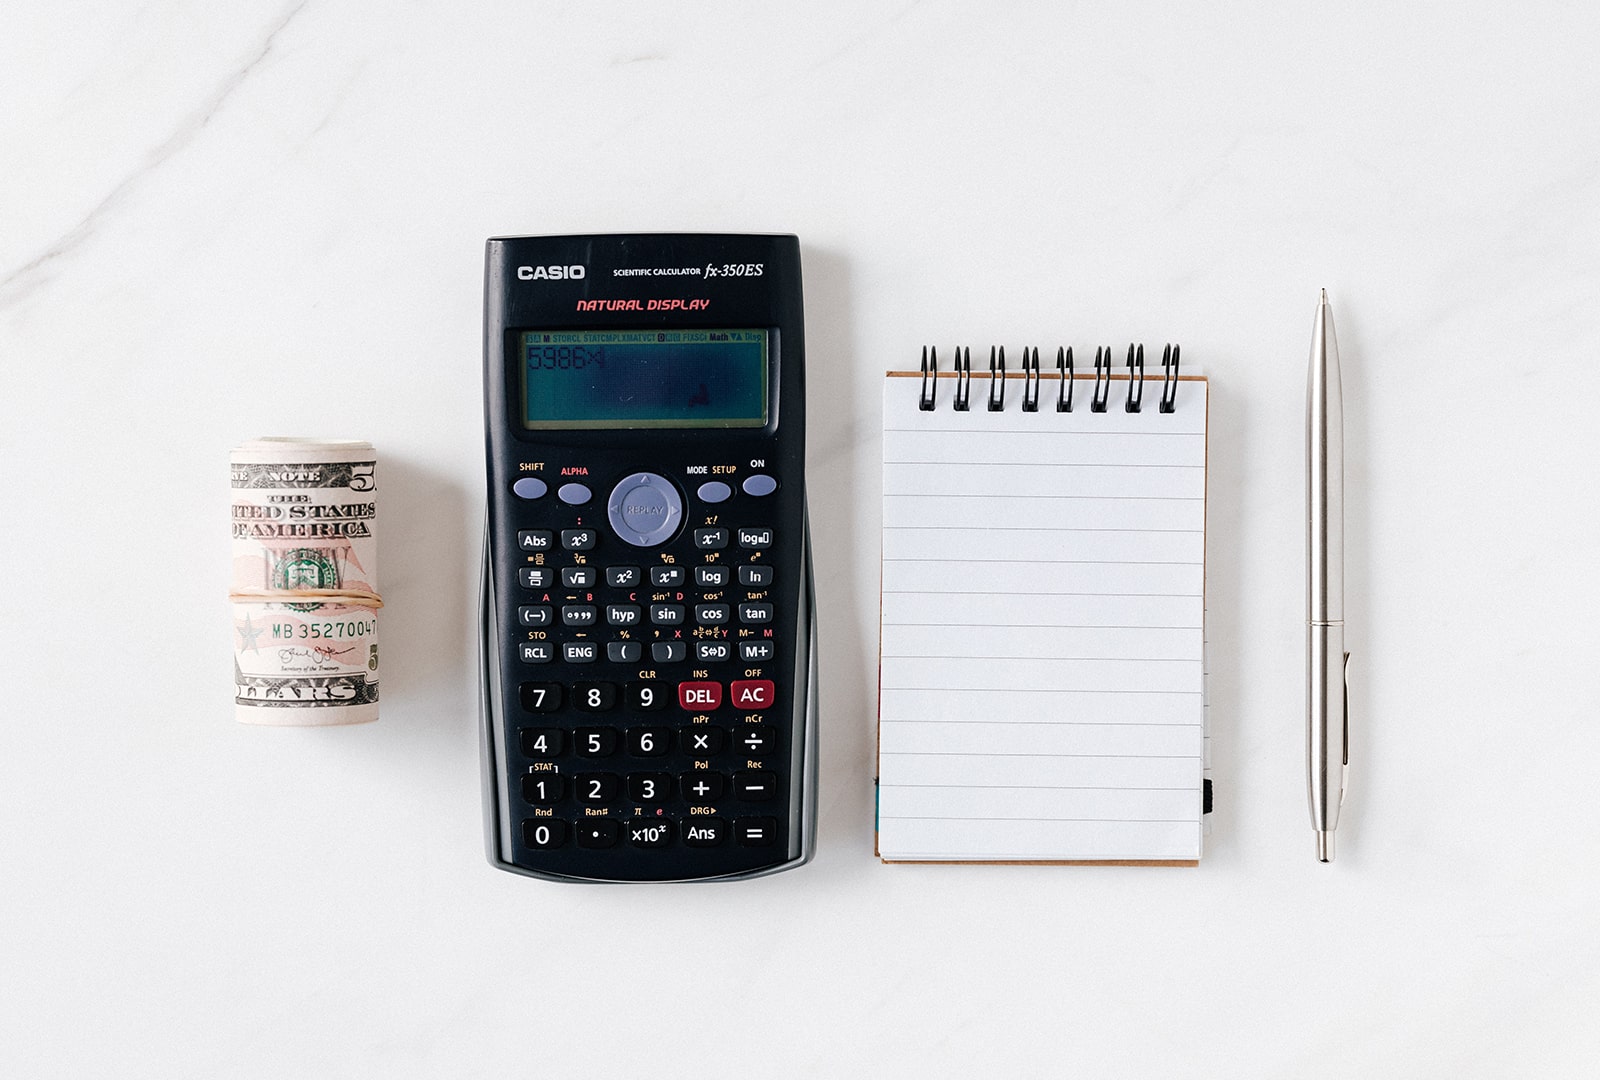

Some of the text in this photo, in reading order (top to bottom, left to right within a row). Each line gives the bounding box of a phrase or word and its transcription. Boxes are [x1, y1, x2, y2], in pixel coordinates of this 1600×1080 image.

[517, 265, 585, 280] CASIO
[613, 263, 763, 279] SCIENTIFIC CALCULATOR fx-350ES
[576, 299, 710, 311] NATURAL DISPLAY
[709, 333, 728, 341] Math
[519, 463, 544, 471] SHIFT
[750, 459, 765, 468] ON
[561, 467, 588, 475] ALPHA
[686, 466, 708, 474] MODE
[268, 471, 321, 482] NOTE
[267, 495, 312, 503] THE
[289, 503, 376, 520] STATES
[627, 505, 664, 514] REPLAY
[250, 522, 371, 539] AMERICA
[523, 535, 547, 546] Abs
[702, 571, 721, 584] log
[586, 593, 593, 601] B
[676, 592, 684, 600] D
[612, 608, 635, 622] hyp
[658, 608, 676, 619] sin
[702, 610, 722, 619] cos
[746, 608, 766, 619] tan
[272, 619, 376, 639] MB 35270047
[674, 630, 681, 638] X
[721, 629, 729, 637] Y
[763, 629, 773, 637] M
[528, 631, 547, 640] STO
[525, 648, 547, 658] RCL
[568, 647, 593, 658] ENG
[639, 670, 656, 679] CLR
[693, 670, 708, 678] INS
[744, 669, 762, 677] OFF
[533, 689, 546, 707] 7
[587, 688, 601, 707] 8
[640, 688, 653, 707] 9
[685, 689, 715, 703] DEL
[740, 688, 764, 702] AC
[693, 715, 709, 723] nPr
[745, 714, 763, 723] nCr
[533, 735, 548, 753] 4
[588, 734, 601, 752] 5
[640, 733, 654, 751] 6
[534, 762, 553, 771] STAT
[694, 761, 709, 769] Pol
[747, 760, 762, 769] Rec
[536, 781, 545, 799] 1
[588, 780, 601, 798] 2
[642, 780, 655, 798] 3
[535, 808, 553, 816] Rnd
[656, 808, 663, 816] e
[535, 826, 550, 844] 0
[687, 826, 715, 840] Ans
